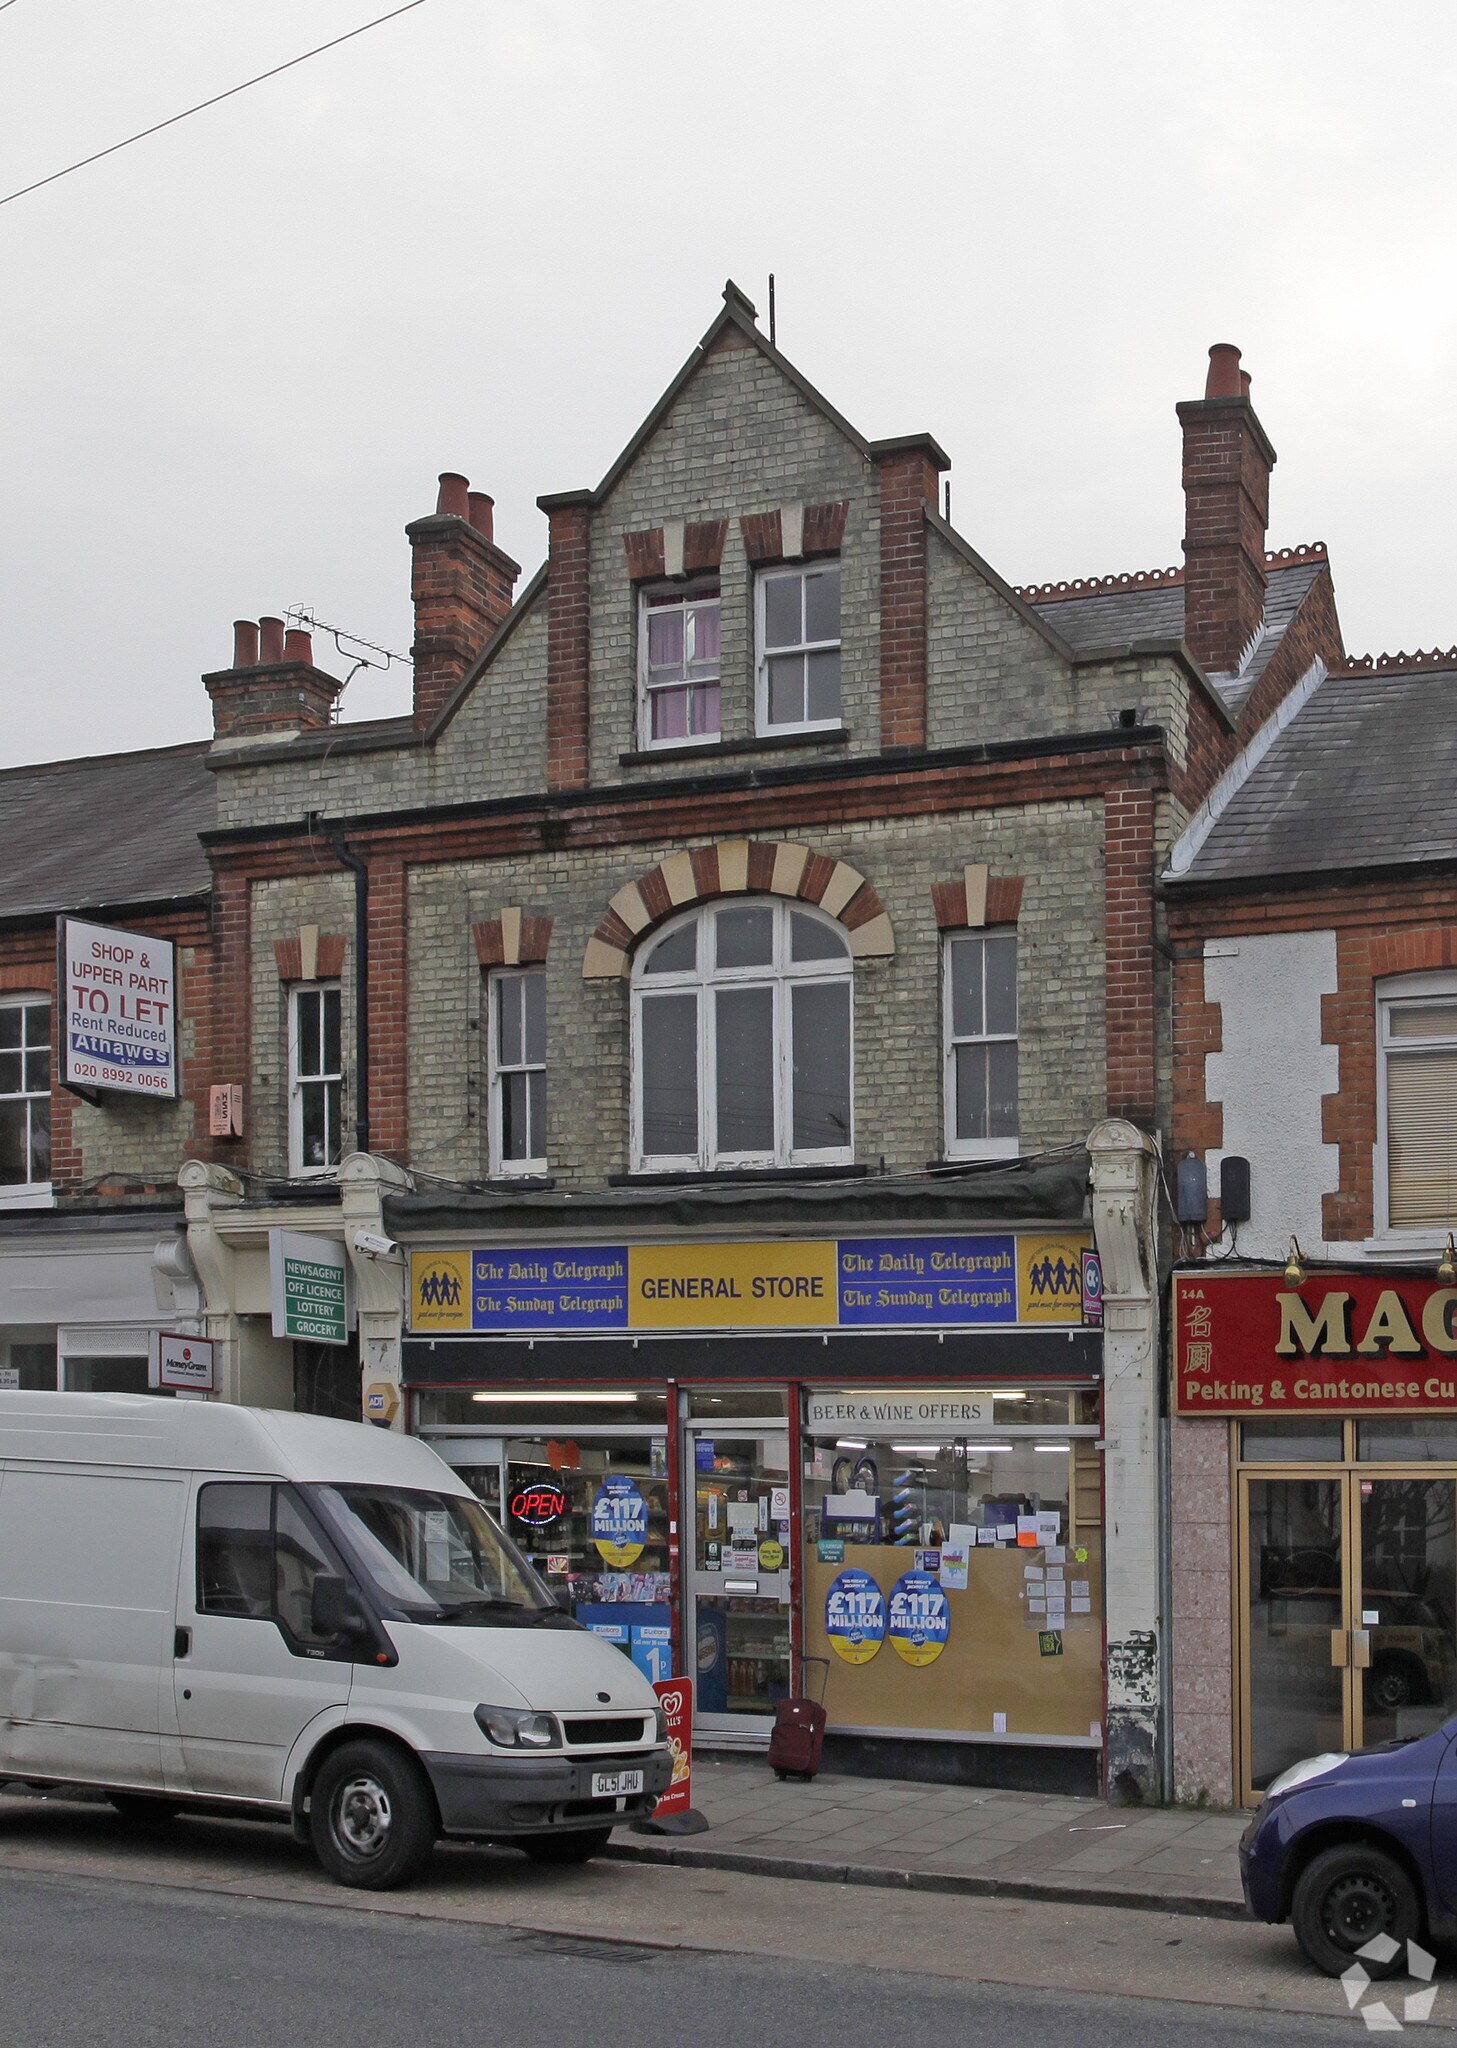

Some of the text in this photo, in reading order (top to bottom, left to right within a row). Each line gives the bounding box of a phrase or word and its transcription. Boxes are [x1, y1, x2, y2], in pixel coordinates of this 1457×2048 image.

[91, 941, 150, 968] SHOP &
[72, 961, 168, 995] UPPER PART
[72, 985, 169, 1025] TO LET
[72, 1012, 167, 1043] Rent Reduced
[74, 1062, 97, 1078] 020
[102, 1067, 133, 1083] 8992
[138, 1073, 168, 1089] 0056
[287, 1262, 342, 1281] NEWSAGENT
[476, 1263, 503, 1280] The
[508, 1262, 548, 1283] Daily
[553, 1260, 624, 1282] Telegraph
[842, 1253, 874, 1273] The
[879, 1252, 925, 1275] Daily
[930, 1250, 1012, 1274] Telegraph
[288, 1281, 342, 1300] OFF LICENCE
[641, 1276, 824, 1299] GENERAL STORE
[842, 1287, 1012, 1309] The Sunday Telegraph
[1181, 1289, 1205, 1299] 24A
[297, 1301, 335, 1317] LOTTERY
[476, 1294, 624, 1315] The Sunday Telegraph
[296, 1321, 337, 1336] GROCERY
[1275, 1288, 1457, 1353] MAG
[166, 1358, 207, 1371] MoneyGram
[368, 1395, 384, 1408] ADT
[1186, 1378, 1455, 1405] Peking & Cantonese Cu
[813, 1403, 982, 1420] BEER & WINE OFFERS
[511, 1494, 566, 1516] OPEN
[594, 1498, 643, 1519] £117
[594, 1519, 645, 1532] MILLION
[828, 1592, 881, 1614] £117
[890, 1592, 945, 1616] £117
[828, 1614, 883, 1628] MILLION
[890, 1616, 947, 1629] MILLION
[621, 1772, 638, 1790] JHU
